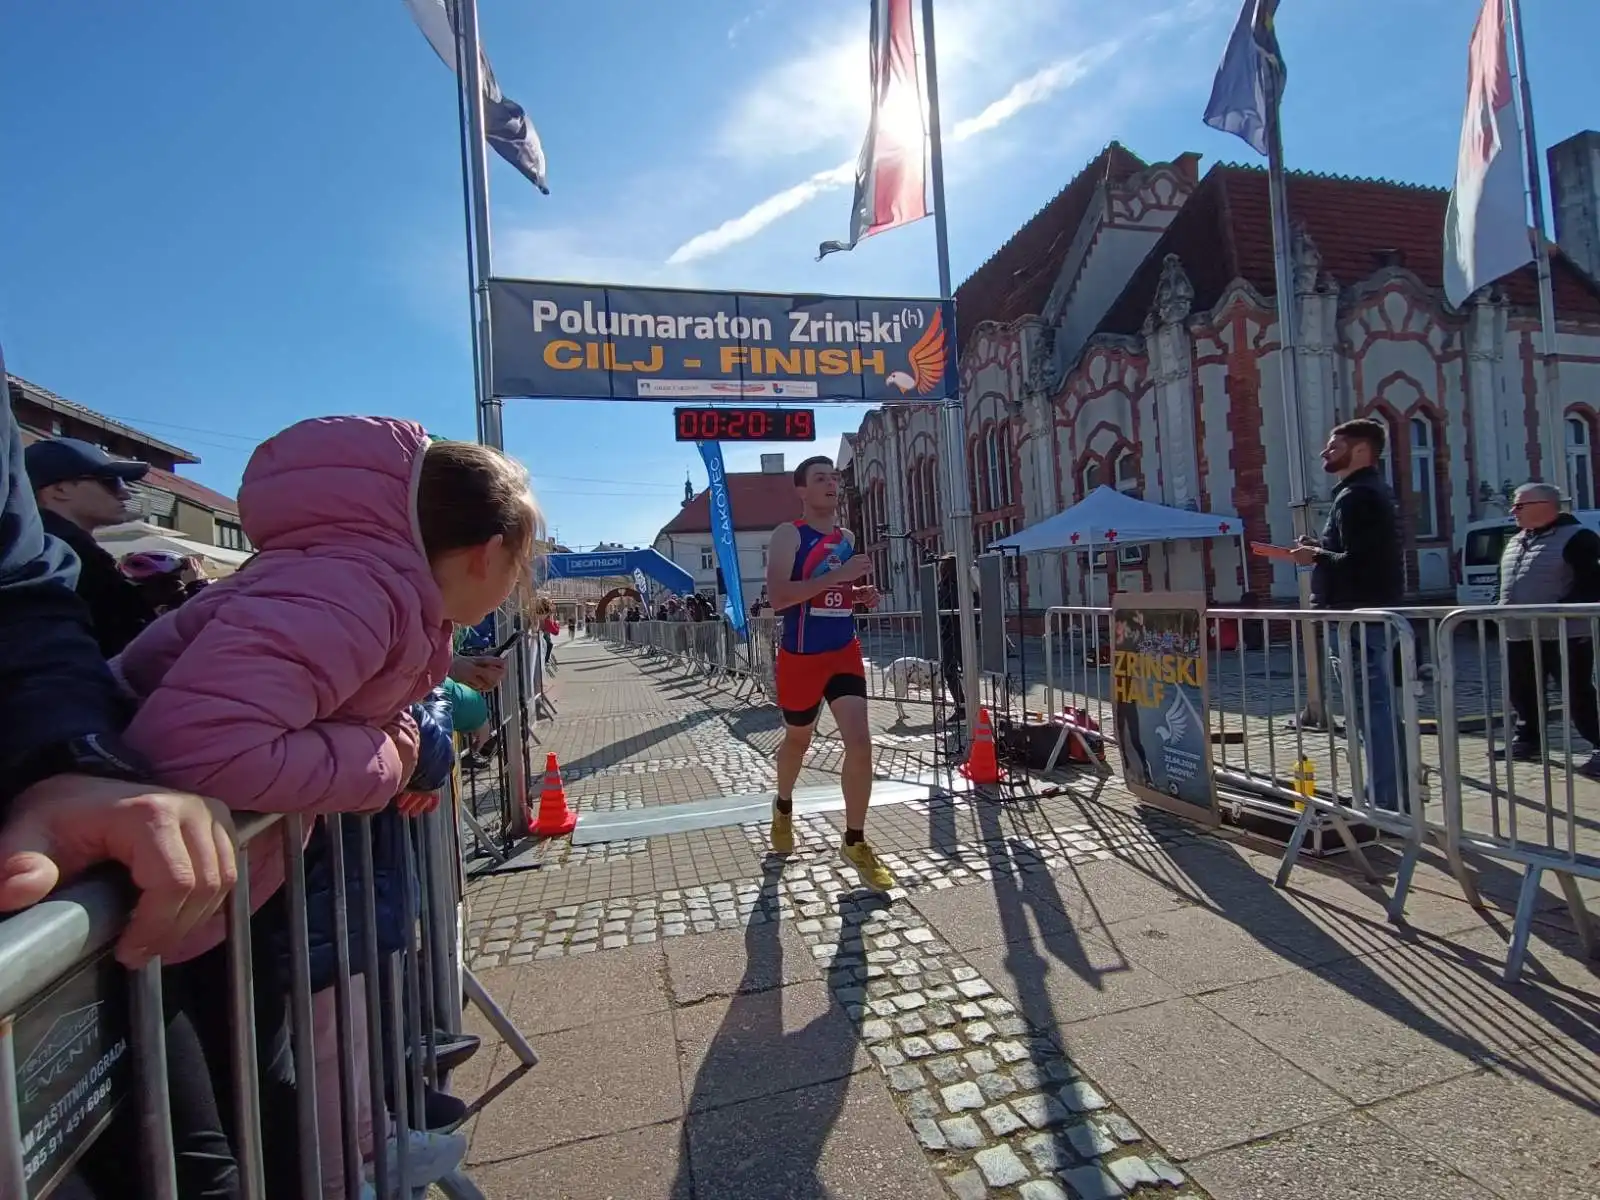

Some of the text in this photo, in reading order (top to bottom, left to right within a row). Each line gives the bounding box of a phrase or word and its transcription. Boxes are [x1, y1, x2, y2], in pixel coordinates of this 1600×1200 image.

[532, 299, 772, 342] Polumaraton
[543, 339, 664, 372] CILJ
[719, 346, 886, 376] FINISH
[680, 410, 811, 438] 00:20:19
[710, 457, 732, 546] ČAKOVEC
[570, 556, 622, 570] DECATHLON
[824, 592, 844, 608] 69
[1113, 650, 1204, 687] ZRINSKI
[1113, 675, 1165, 709] HALF
[25, 1026, 98, 1104] EVENTI
[49, 1129, 63, 1155] 91
[65, 1104, 85, 1133] 451
